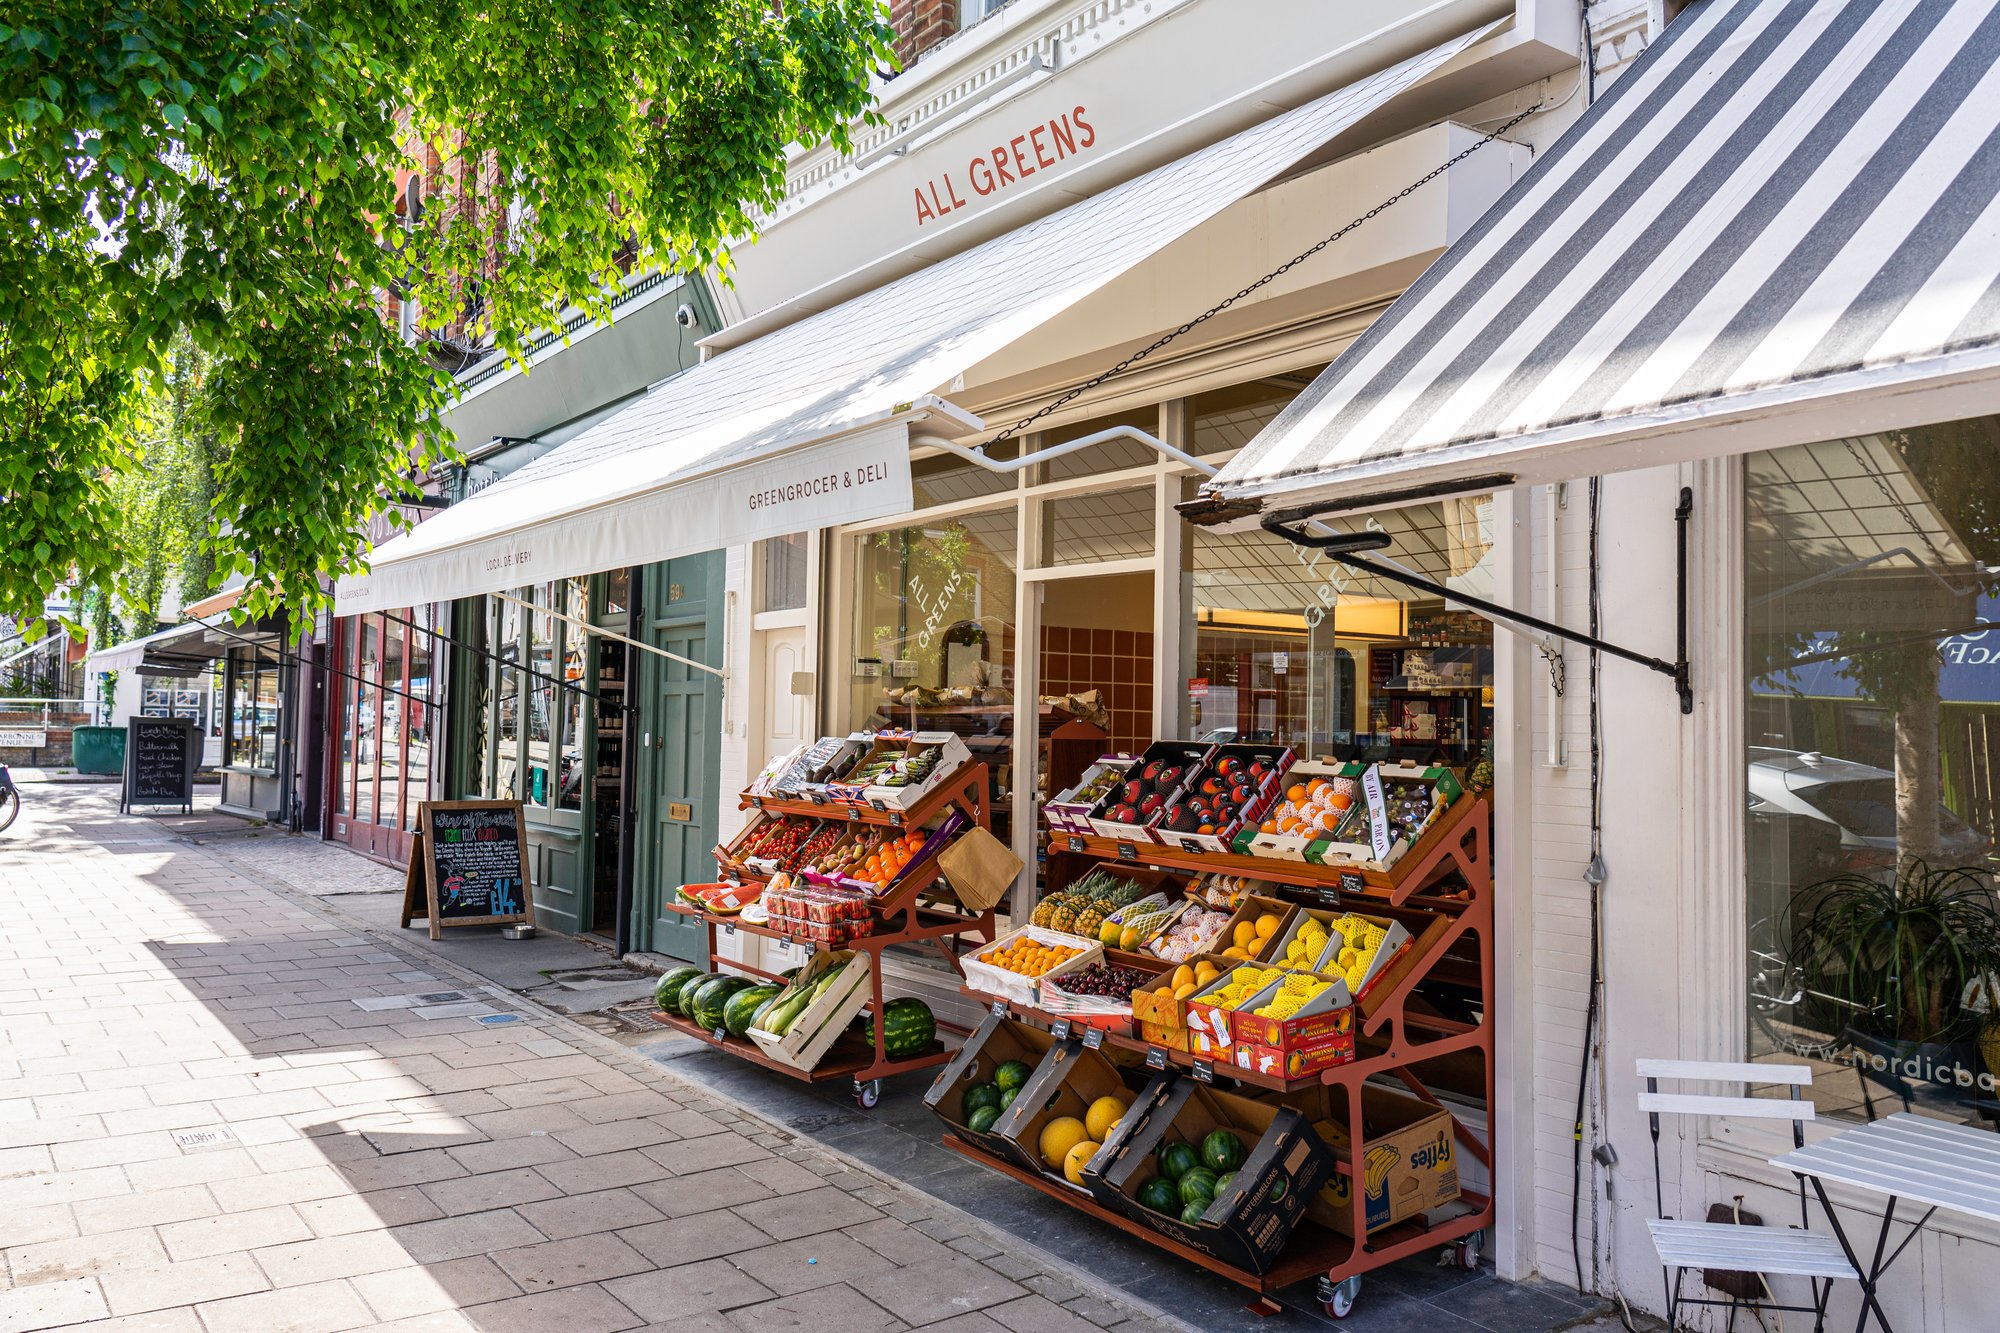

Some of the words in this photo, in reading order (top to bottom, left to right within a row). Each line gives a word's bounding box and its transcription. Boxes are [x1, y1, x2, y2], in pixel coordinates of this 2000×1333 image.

[914, 173, 966, 225] ALL
[969, 106, 1095, 196] GREENS
[749, 474, 838, 510] GREENGROCER
[843, 471, 852, 488] &
[857, 462, 888, 485] DELI
[908, 574, 929, 613] ALL
[1303, 517, 1384, 628] GRES
[918, 569, 961, 648] GREENS
[1367, 784, 1378, 800] AIR
[1374, 823, 1383, 838] PAR
[1411, 1139, 1450, 1170] fyffes
[1239, 1167, 1279, 1221] WATERMELONS
